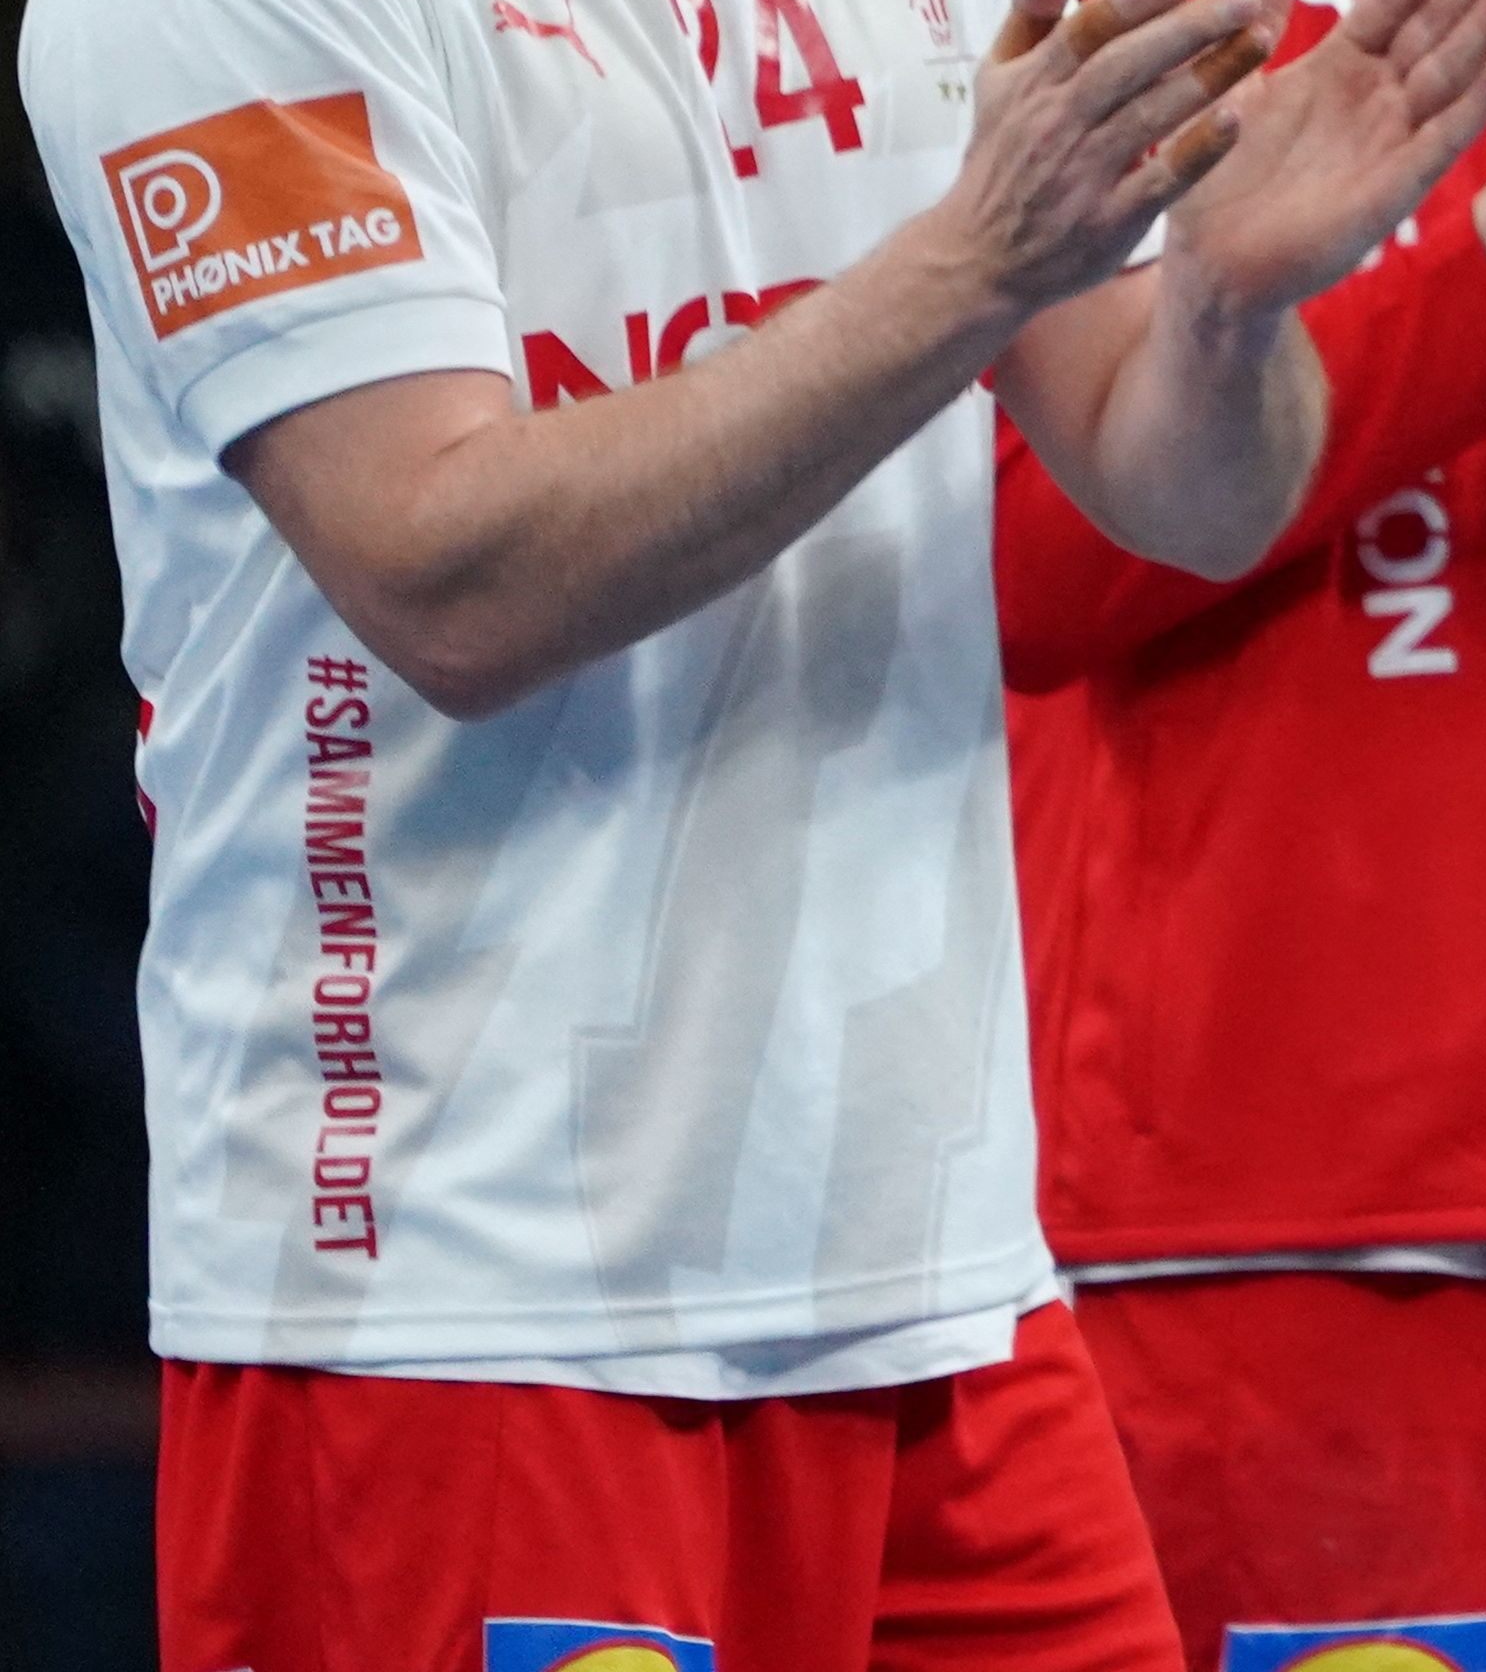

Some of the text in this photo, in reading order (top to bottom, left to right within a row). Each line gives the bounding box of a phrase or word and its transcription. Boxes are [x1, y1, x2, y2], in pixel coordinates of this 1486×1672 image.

[151, 207, 401, 316] PHØNIX TAG
[303, 653, 384, 1262] #SAMMENFORHOLDET
